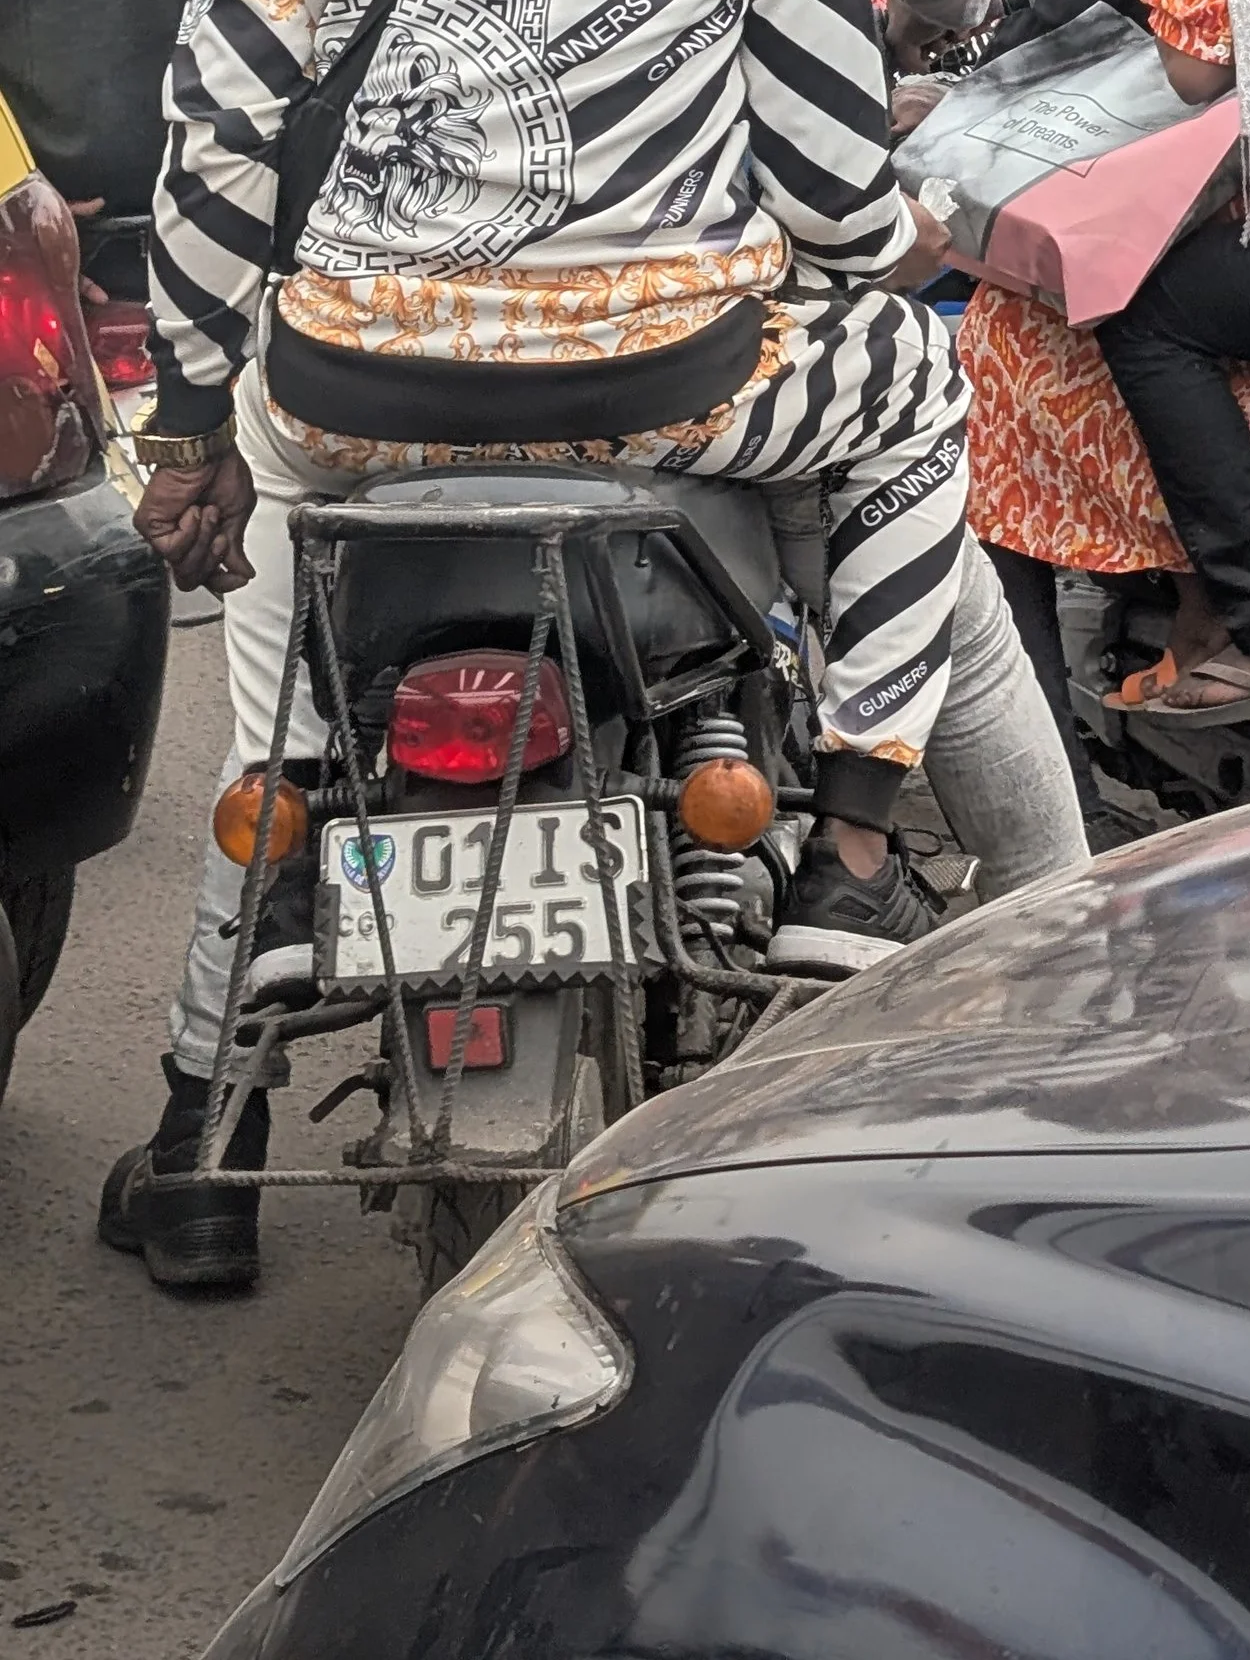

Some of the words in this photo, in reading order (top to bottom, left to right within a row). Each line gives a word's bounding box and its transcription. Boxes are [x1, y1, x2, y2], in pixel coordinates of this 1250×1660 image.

[1002, 117, 1027, 129] of
[1055, 105, 1110, 137] Power
[861, 437, 961, 529] GUNNERS
[858, 660, 929, 718] GUNNERS
[441, 897, 588, 971] 255
